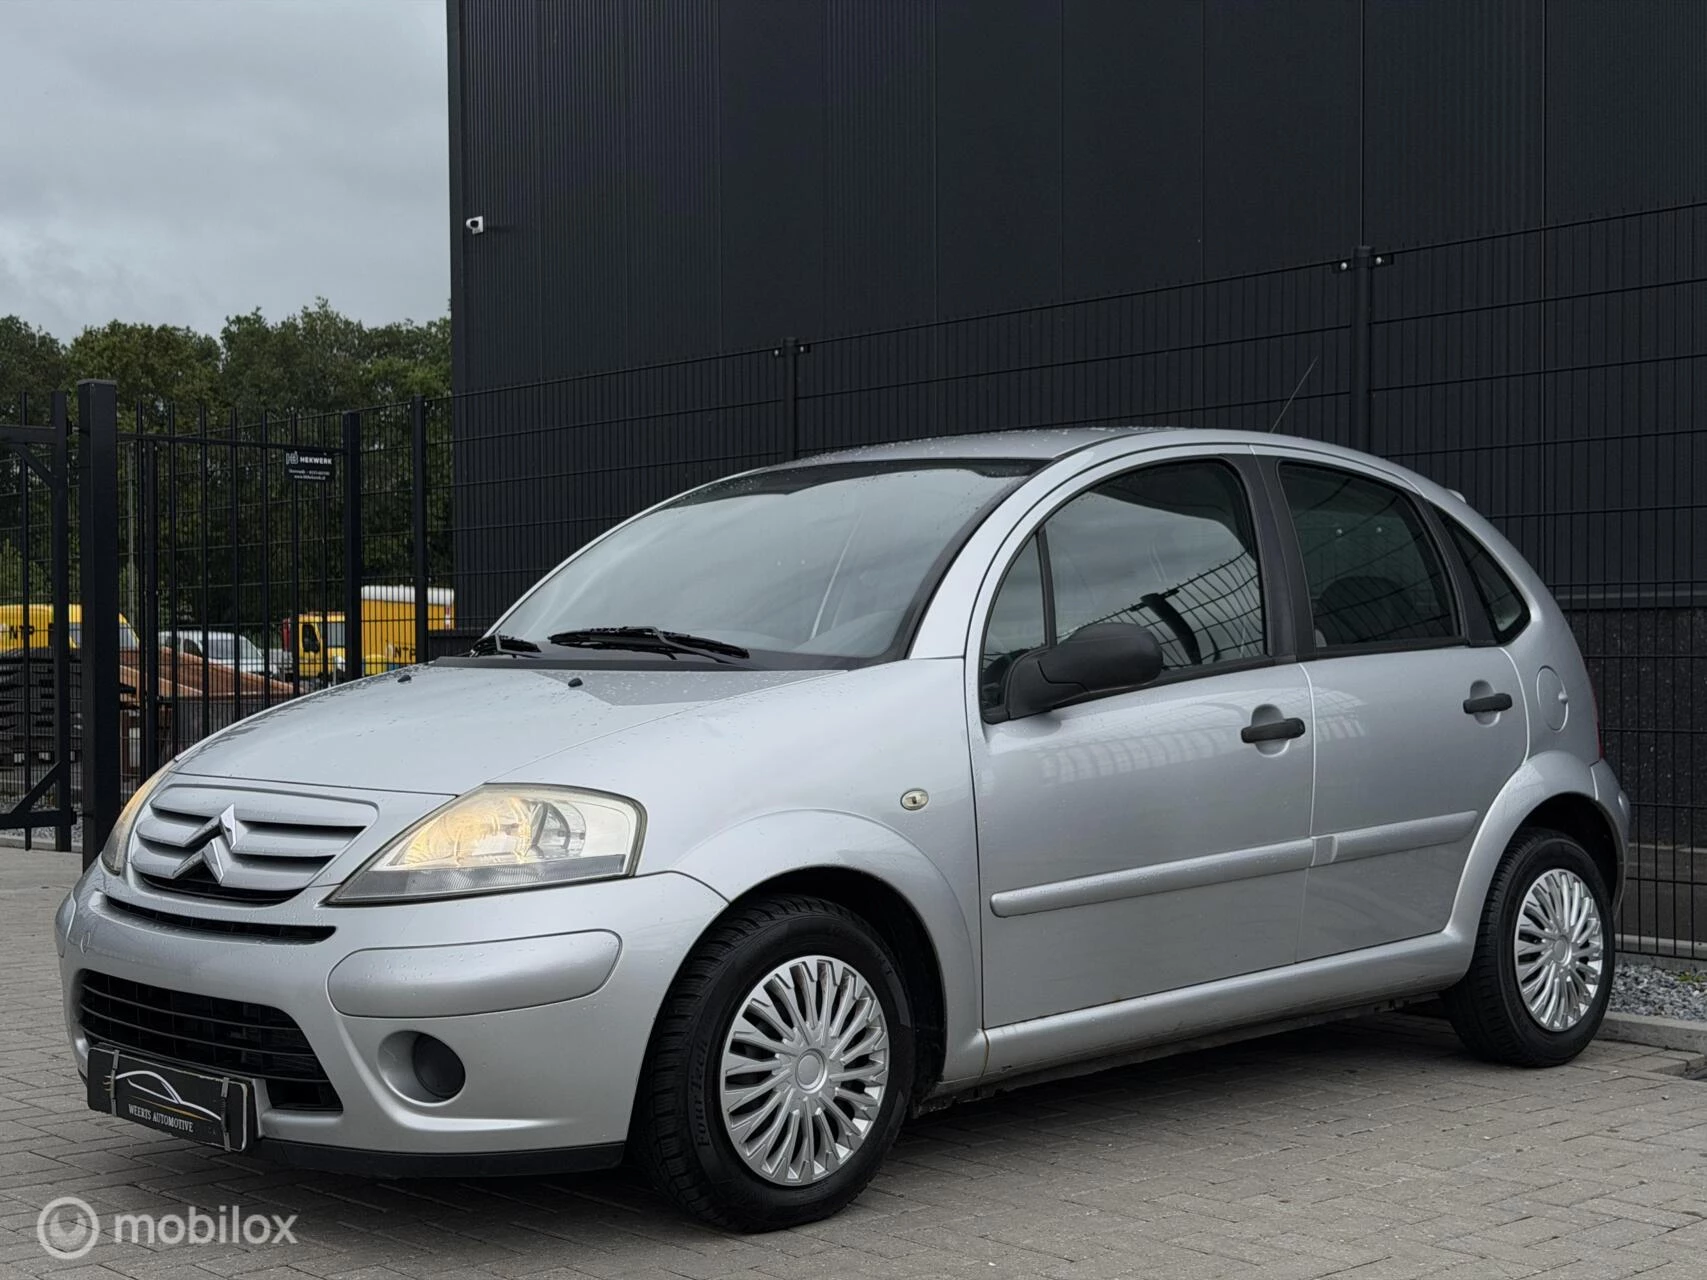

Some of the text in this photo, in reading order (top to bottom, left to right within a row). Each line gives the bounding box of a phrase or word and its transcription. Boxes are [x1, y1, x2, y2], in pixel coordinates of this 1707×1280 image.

[300, 456, 332, 464] HEKWERK
[128, 1103, 194, 1133] WEERTS AUTOMOTIVE
